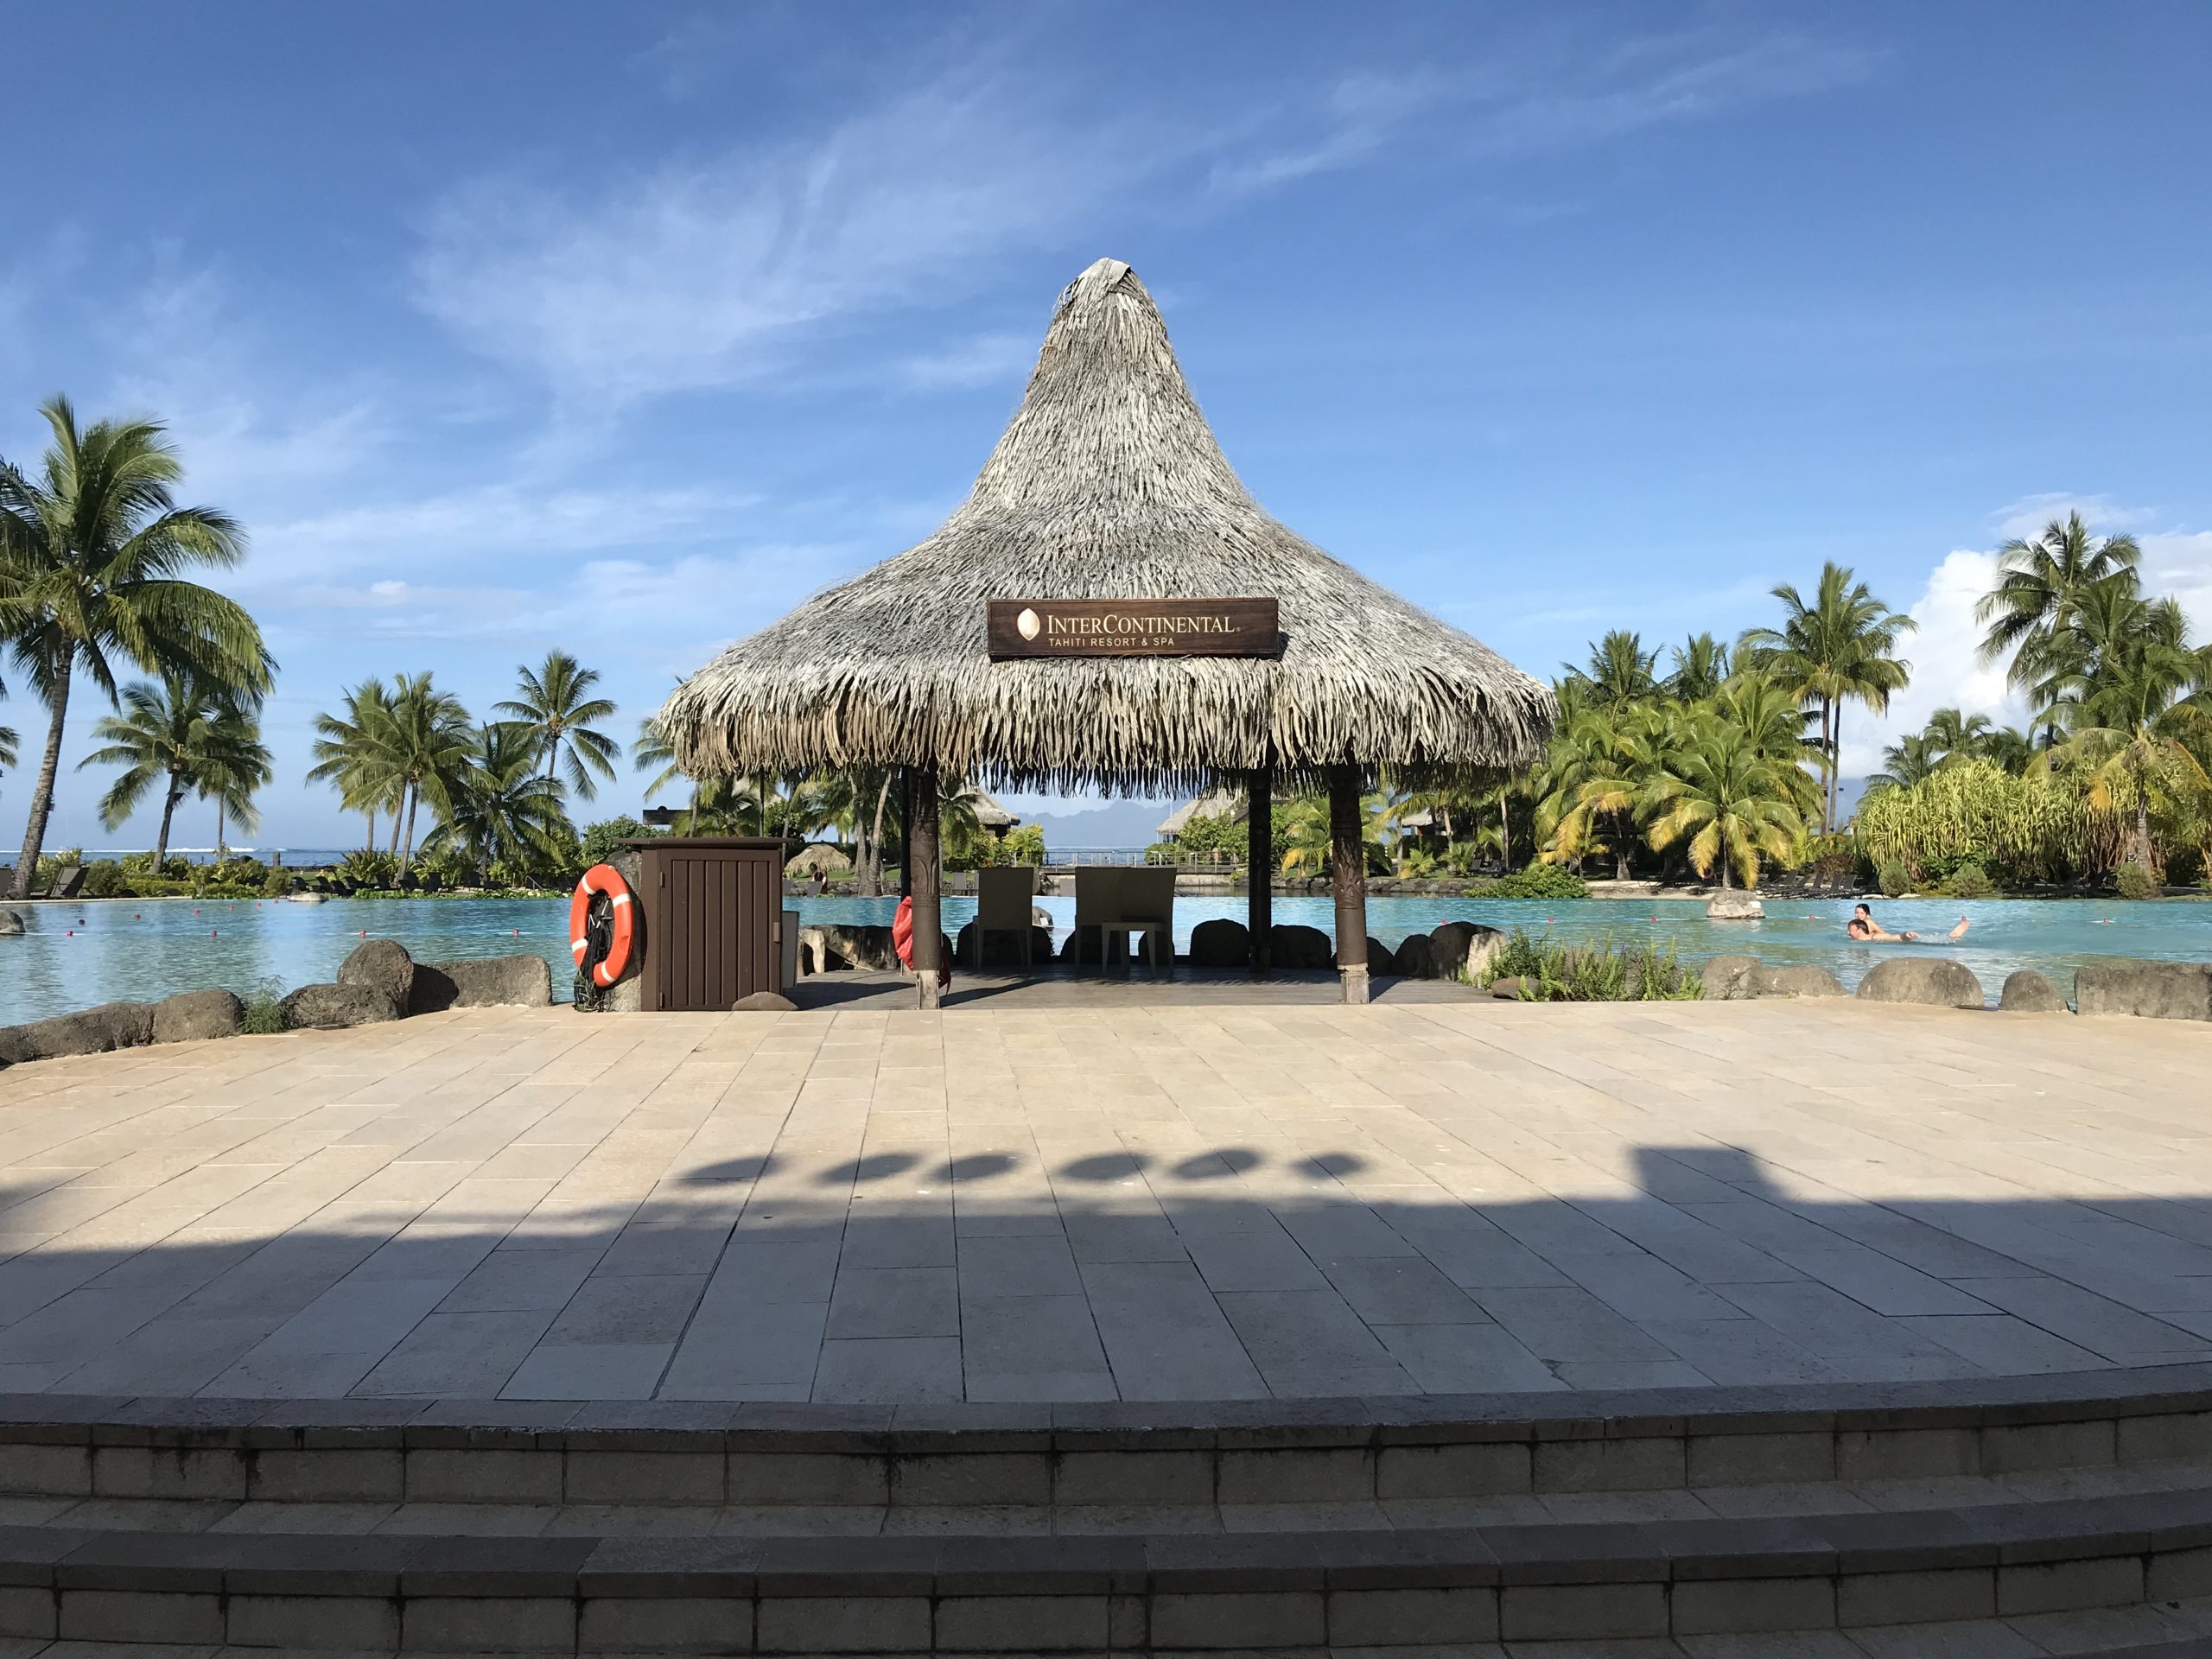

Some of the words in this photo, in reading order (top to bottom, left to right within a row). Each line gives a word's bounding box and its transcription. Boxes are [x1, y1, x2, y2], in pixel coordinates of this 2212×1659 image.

[1049, 638, 1085, 647] TAHITI
[1090, 638, 1136, 647] RESORT
[1141, 638, 1149, 646] &
[1153, 637, 1174, 646] SPA
